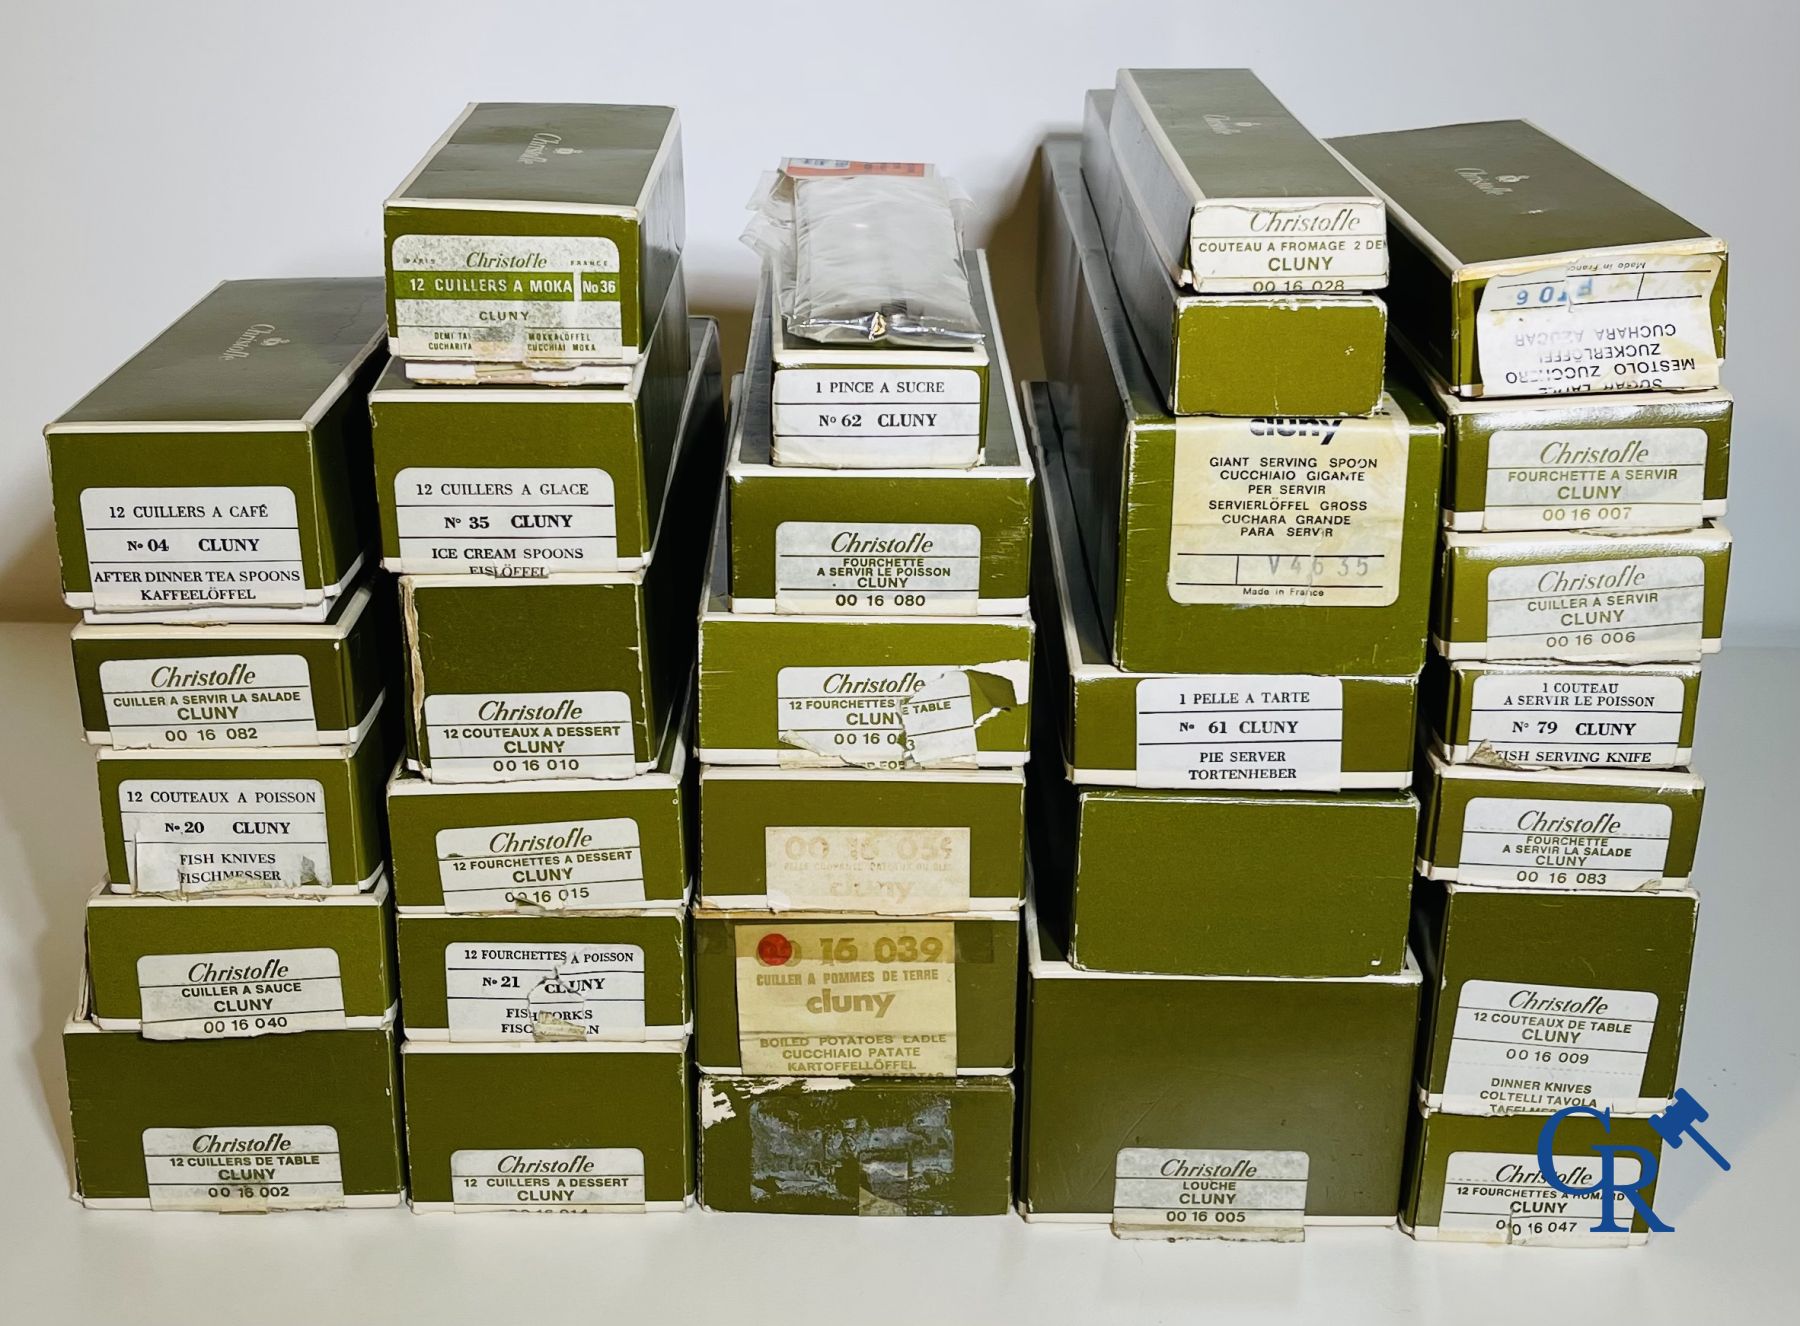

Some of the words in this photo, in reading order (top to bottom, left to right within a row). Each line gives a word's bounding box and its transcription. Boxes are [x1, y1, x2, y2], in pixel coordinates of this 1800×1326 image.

[1250, 209, 1360, 232] Christofle
[466, 252, 548, 268] Christofle
[1268, 257, 1333, 271] CLUNY
[410, 279, 424, 291] 12
[435, 279, 507, 291] CUILLERS
[513, 280, 522, 292] A
[530, 280, 572, 292] MOKA
[479, 311, 529, 320] CLUNY
[830, 382, 874, 393] PINCE
[880, 383, 890, 393] A
[896, 382, 945, 393] SUCRE
[878, 414, 937, 427] CLUNY
[1540, 441, 1648, 464] Christofle
[1210, 458, 1249, 467] GIANT
[1260, 458, 1318, 467] SERVING
[1329, 458, 1377, 468] SPOON
[1220, 471, 1296, 480] CUCCHIAIO
[1306, 472, 1365, 481] GIGANTE
[1508, 470, 1606, 482] FOURCHETTE
[1611, 470, 1620, 480] A
[1625, 469, 1677, 479] SERVIR
[416, 484, 432, 495] 12
[440, 484, 513, 495] CUILLERS
[522, 484, 531, 495] A
[540, 484, 589, 495] GLACE
[1248, 485, 1272, 494] PER
[1280, 485, 1326, 494] SERVIR
[1558, 486, 1622, 499] CLUNY
[1209, 497, 1309, 510] SERVIERLÖFFEL
[1320, 501, 1367, 510] GROSS
[110, 507, 125, 518] 12
[133, 506, 205, 518] CUILLERS
[213, 507, 222, 517] A
[230, 504, 268, 517] CAFÉ
[511, 515, 573, 528] CLUNY
[1222, 515, 1286, 524] CUCHARA
[1296, 516, 1351, 525] GRANDE
[198, 539, 260, 551] CLUNY
[831, 532, 933, 553] Christofle
[432, 549, 458, 559] ICE
[464, 549, 516, 559] CREAM
[523, 549, 584, 559] SPOONS
[844, 558, 924, 567] FOURCHETTE
[94, 572, 141, 582] AFTER
[145, 572, 202, 582] DINNER
[205, 571, 236, 582] TEA
[240, 571, 300, 581] SPOONS
[817, 568, 825, 576] A
[829, 568, 872, 576] SERVIR
[878, 568, 890, 576] LE
[896, 568, 950, 576] POISSON
[858, 578, 908, 588] CLUNY
[1537, 565, 1645, 593] Christofle
[141, 587, 256, 600] KAFFEELÖFFEL
[1528, 600, 1588, 611] CUILLER
[1592, 598, 1601, 607] A
[1607, 593, 1658, 605] SERVIR
[1561, 610, 1624, 626] CLUNY
[151, 663, 256, 688] Christofle
[823, 672, 926, 694] Christofle
[113, 697, 165, 707] CUILLER
[170, 696, 178, 705] A
[183, 694, 227, 704] SERVIR
[231, 693, 247, 703] LA
[252, 692, 300, 702] SALADE
[1194, 693, 1239, 704] PELLE
[1245, 693, 1254, 703] A
[1261, 692, 1310, 703] TARTE
[1504, 697, 1512, 705] A
[1518, 696, 1569, 706] SERVIR
[1575, 697, 1591, 706] LE
[1598, 697, 1655, 707] POISSON
[178, 707, 238, 720] CLUNY
[478, 700, 583, 721] Christofle
[444, 730, 458, 739] 12
[462, 728, 539, 738] COUTEAUX
[543, 728, 551, 737] A
[557, 726, 620, 737] DESSERT
[1239, 721, 1298, 733] CLUNY
[1576, 723, 1636, 736] CLUNY
[504, 741, 565, 753] CLUNY
[1200, 752, 1224, 762] PIE
[1230, 751, 1286, 762] SERVER
[1189, 769, 1297, 780] TORTENHEBER
[127, 792, 142, 802] 12
[150, 792, 229, 803] COUTEAUX
[238, 793, 247, 803] A
[256, 792, 316, 803] POISSON
[233, 822, 290, 834] CLUNY
[1517, 810, 1621, 834] Christofle
[489, 828, 592, 853] Christofle
[1526, 836, 1609, 847] FOURCHETTE
[1502, 845, 1510, 853] A
[1516, 846, 1559, 854] SERVIR
[1564, 847, 1579, 855] LA
[1584, 847, 1632, 856] SALADE
[180, 854, 214, 865] FISH
[222, 854, 275, 864] KNIVES
[470, 857, 560, 870] FOURCHETTES
[564, 855, 573, 864] A
[577, 851, 632, 863] DESSERT
[1536, 855, 1587, 866] CLUNY
[513, 868, 573, 883] CLUNY
[188, 959, 288, 982] Christofle
[757, 974, 802, 986] CUILLER
[808, 974, 816, 984] A
[824, 971, 875, 984] POMMES
[882, 971, 898, 982] DE
[903, 969, 939, 981] TERRE
[182, 986, 238, 998] CUILLER
[243, 986, 251, 994] A
[256, 982, 301, 993] SAUCE
[214, 999, 273, 1012] CLUNY
[806, 989, 896, 1018] cluny
[1508, 990, 1608, 1015] Christofle
[1474, 1012, 1488, 1022] 12
[1491, 1013, 1565, 1028] COUTEAUX
[1568, 1020, 1585, 1030] DE
[1591, 1022, 1632, 1034] TABLE
[1522, 1028, 1581, 1044] CLUNY
[783, 1049, 861, 1059] CUCCHIAIO
[869, 1048, 921, 1058] PATATE
[787, 1059, 916, 1072] KARTOFFELLÖFFEL
[1491, 1078, 1541, 1091] DINNER
[1544, 1082, 1592, 1094] KNIVES
[1480, 1090, 1542, 1104] COLTELLI
[1547, 1095, 1597, 1107] TAVOLA
[193, 1133, 291, 1153] Christofle
[170, 1158, 184, 1167] 12
[187, 1157, 251, 1167] CUILLERS
[256, 1157, 272, 1166] DE
[277, 1156, 319, 1165] TABLE
[497, 1155, 594, 1174] Christofle
[218, 1169, 276, 1180] CLUNY
[1160, 1159, 1257, 1178] Christofle
[464, 1179, 477, 1187] 12
[487, 1178, 550, 1187] CUILLERS
[557, 1179, 565, 1187] A
[570, 1178, 629, 1187] DESSERT
[1183, 1182, 1236, 1190] LOUCHE
[517, 1190, 574, 1201] CLUNY
[1179, 1194, 1237, 1204] CLUNY
[1509, 1201, 1568, 1214] CLUNY
